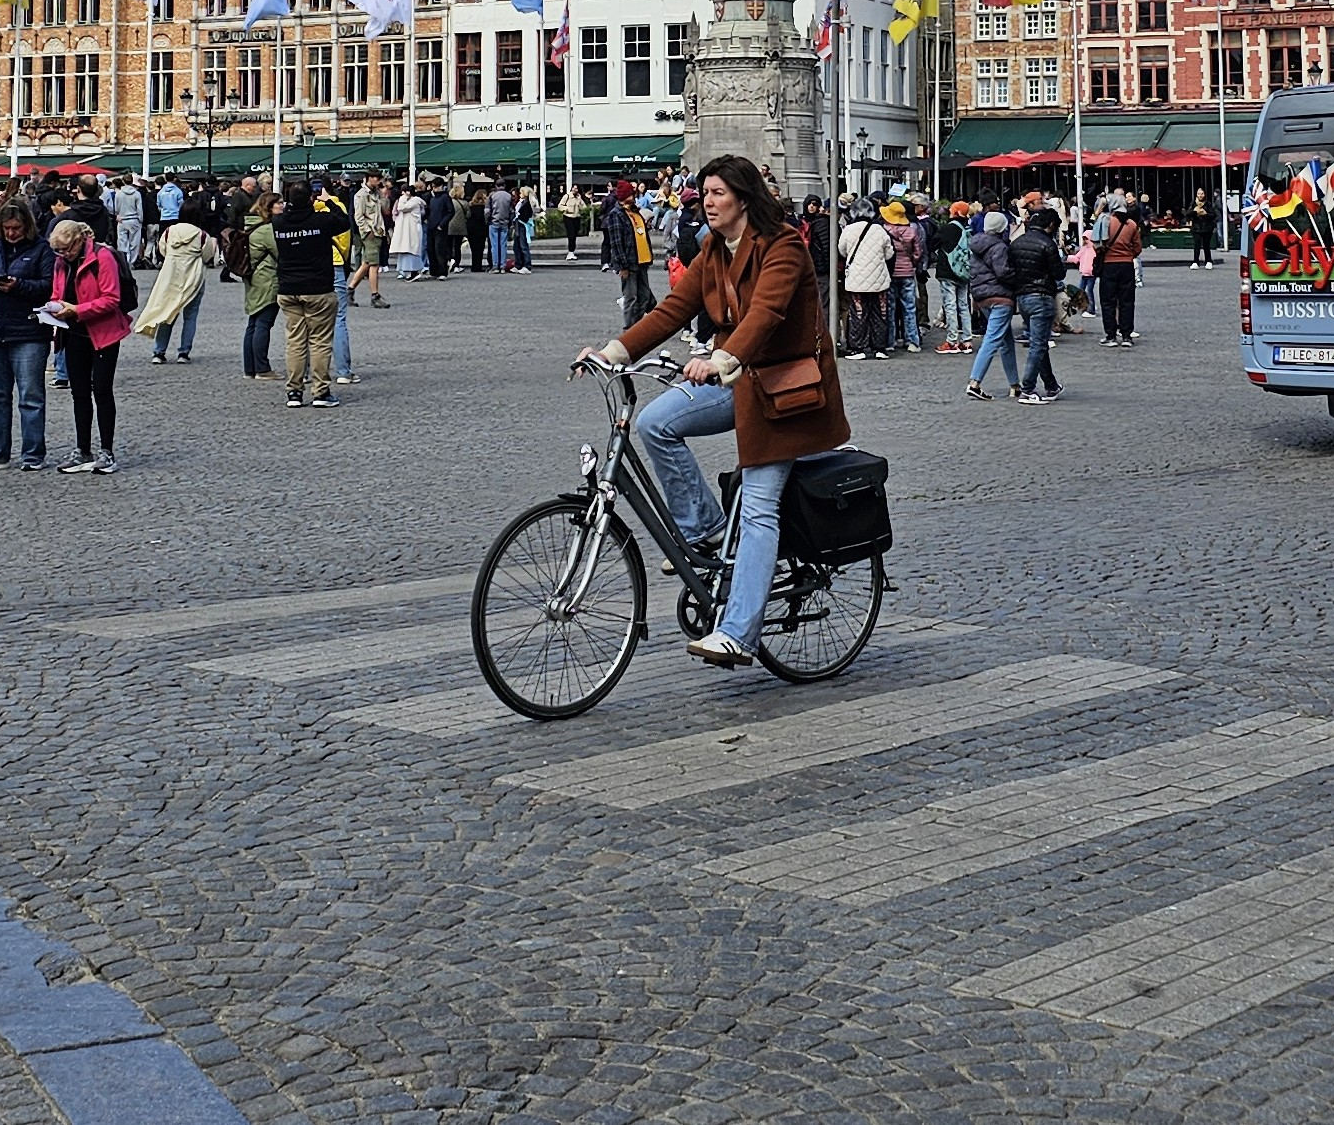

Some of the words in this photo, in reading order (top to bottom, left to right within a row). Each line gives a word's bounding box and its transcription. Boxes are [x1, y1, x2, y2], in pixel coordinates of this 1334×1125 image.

[1226, 15, 1245, 26] LE
[1250, 14, 1303, 26] PANIER
[467, 123, 493, 132] Grand
[495, 122, 514, 132] Café
[525, 121, 553, 131] Belfrt
[1254, 282, 1267, 293] 50
[1268, 282, 1289, 293] min.
[1289, 282, 1313, 293] Tour
